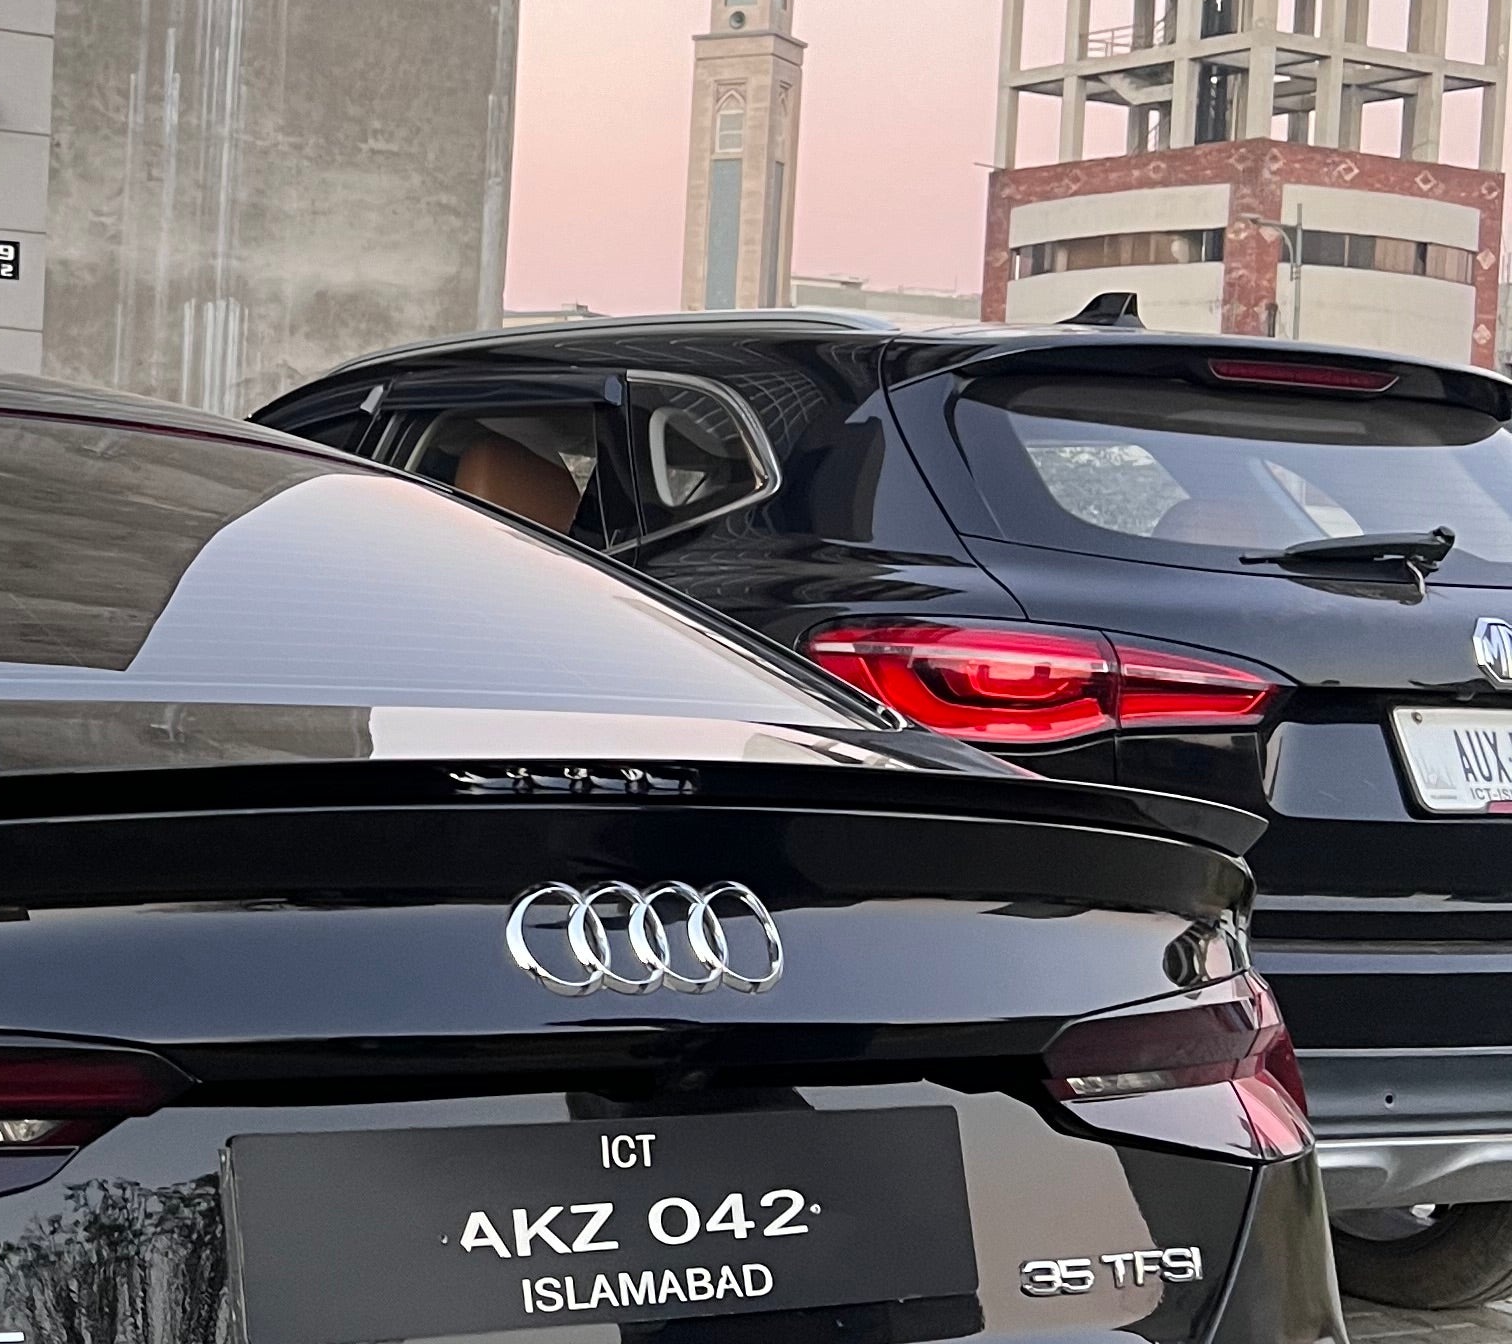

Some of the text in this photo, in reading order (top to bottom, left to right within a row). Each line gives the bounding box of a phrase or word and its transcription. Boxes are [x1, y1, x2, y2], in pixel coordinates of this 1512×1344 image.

[1453, 729, 1512, 783] AUX
[1470, 787, 1512, 801] ICT-IS
[600, 1134, 656, 1169] ICT
[459, 1188, 810, 1258] AKZ 042
[521, 1263, 775, 1314] ISLAMABAD
[1021, 1246, 1204, 1297] 35 TFSI
